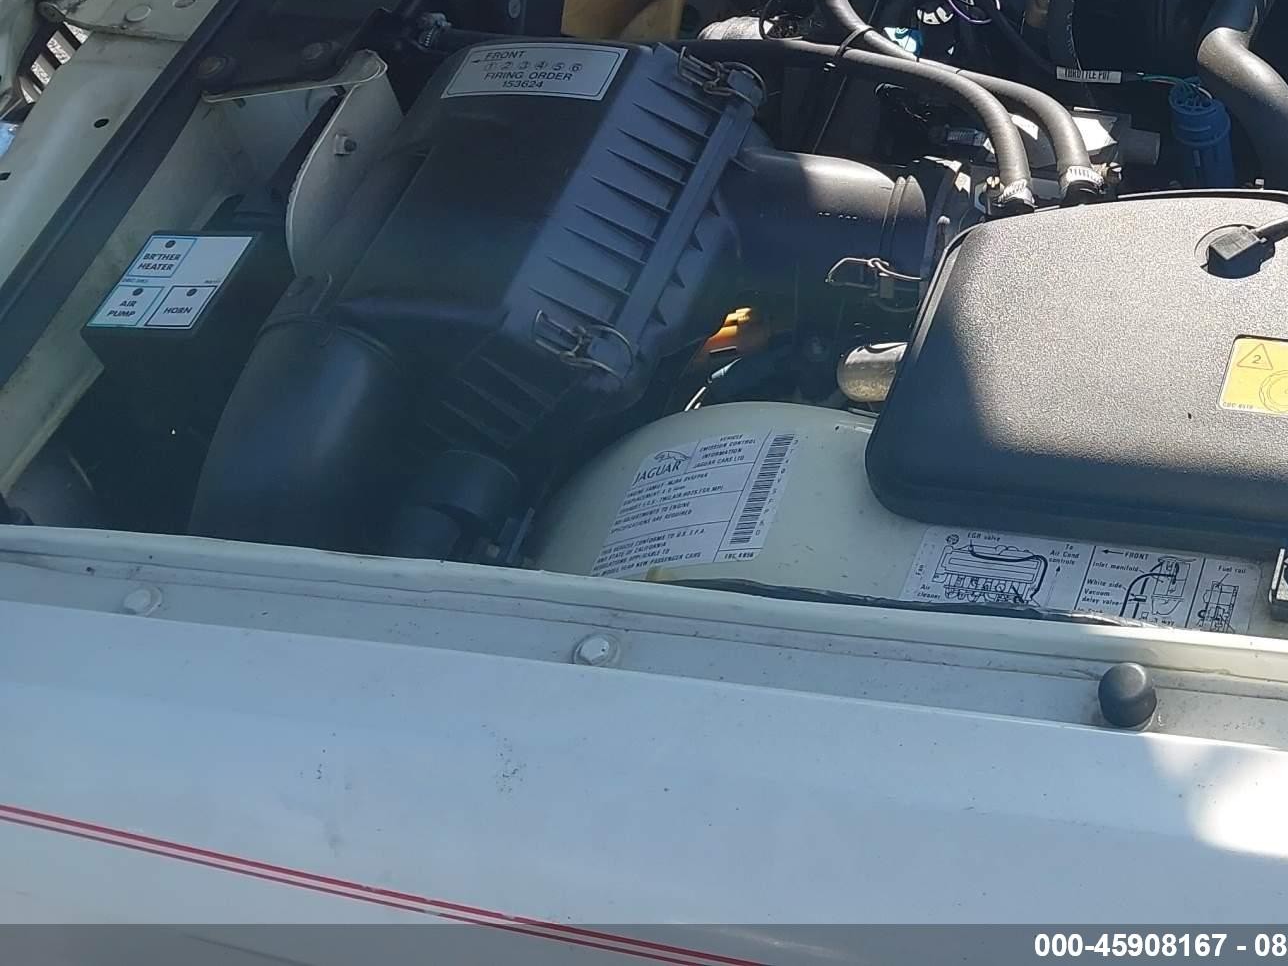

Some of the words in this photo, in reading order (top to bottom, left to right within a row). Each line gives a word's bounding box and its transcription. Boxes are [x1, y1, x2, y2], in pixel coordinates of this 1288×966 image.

[485, 50, 526, 60] FRONT
[484, 72, 523, 80] FIRING
[528, 72, 573, 81] ORDER
[502, 80, 544, 88] 153624
[137, 263, 175, 271] HEATER
[1251, 354, 1262, 365] 2
[632, 460, 682, 486] JAGUAR
[1124, 551, 1149, 561] FRONT
[1092, 561, 1109, 569] Inlet
[1110, 564, 1139, 573] manifold
[1087, 579, 1106, 587] White
[1084, 588, 1110, 597] Vacuum
[1082, 597, 1100, 606] delay
